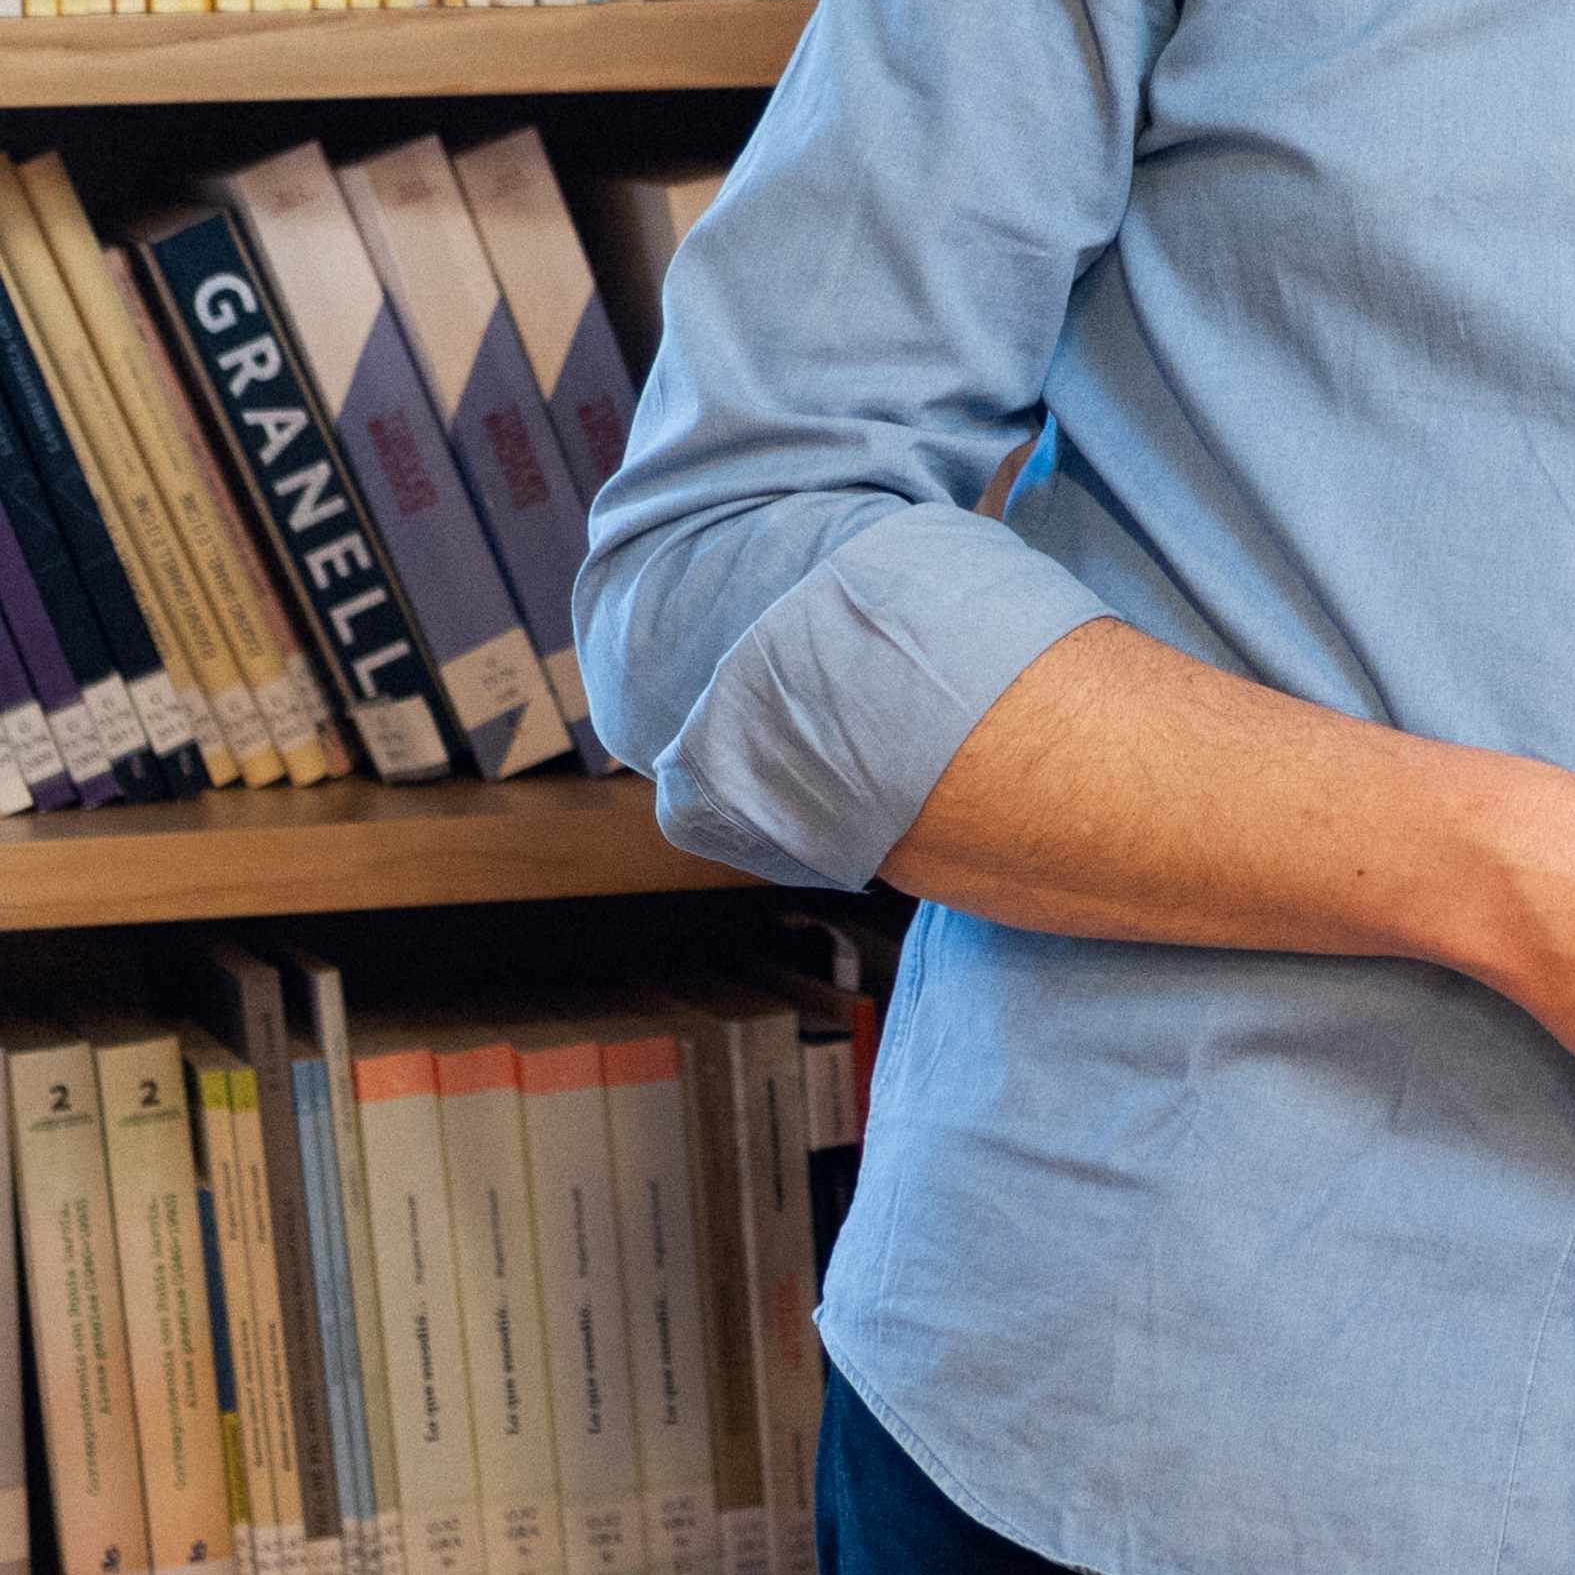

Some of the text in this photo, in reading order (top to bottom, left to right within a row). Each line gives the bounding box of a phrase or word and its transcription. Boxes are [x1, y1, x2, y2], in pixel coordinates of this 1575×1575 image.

[193, 274, 412, 699] GRANELL
[49, 1086, 71, 1112] 2
[138, 1080, 160, 1106] 2
